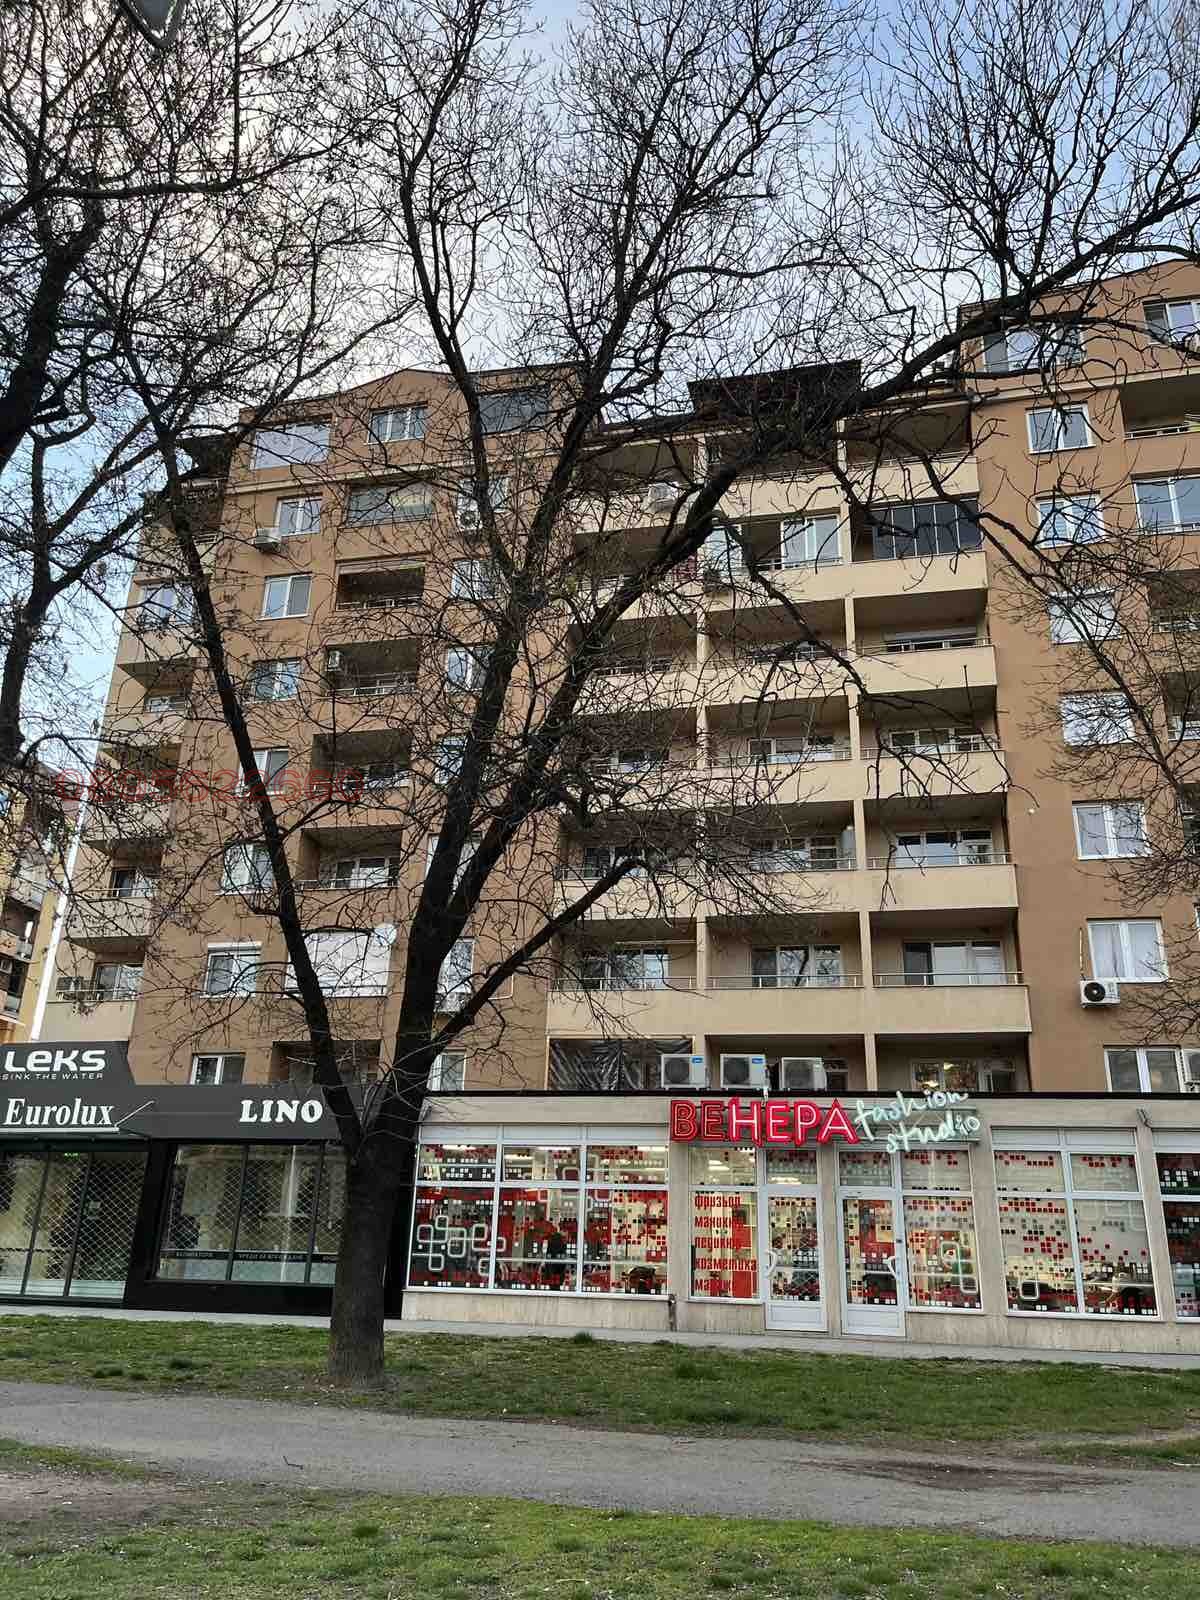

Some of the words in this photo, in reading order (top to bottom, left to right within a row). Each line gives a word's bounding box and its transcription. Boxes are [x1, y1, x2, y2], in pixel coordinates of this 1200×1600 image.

[2, 1097, 115, 1126] Eurolux
[239, 1099, 323, 1123] LINO
[670, 1098, 860, 1146] ВЕНЕРА
[854, 1089, 968, 1140] fashion
[886, 1110, 980, 1153] studio
